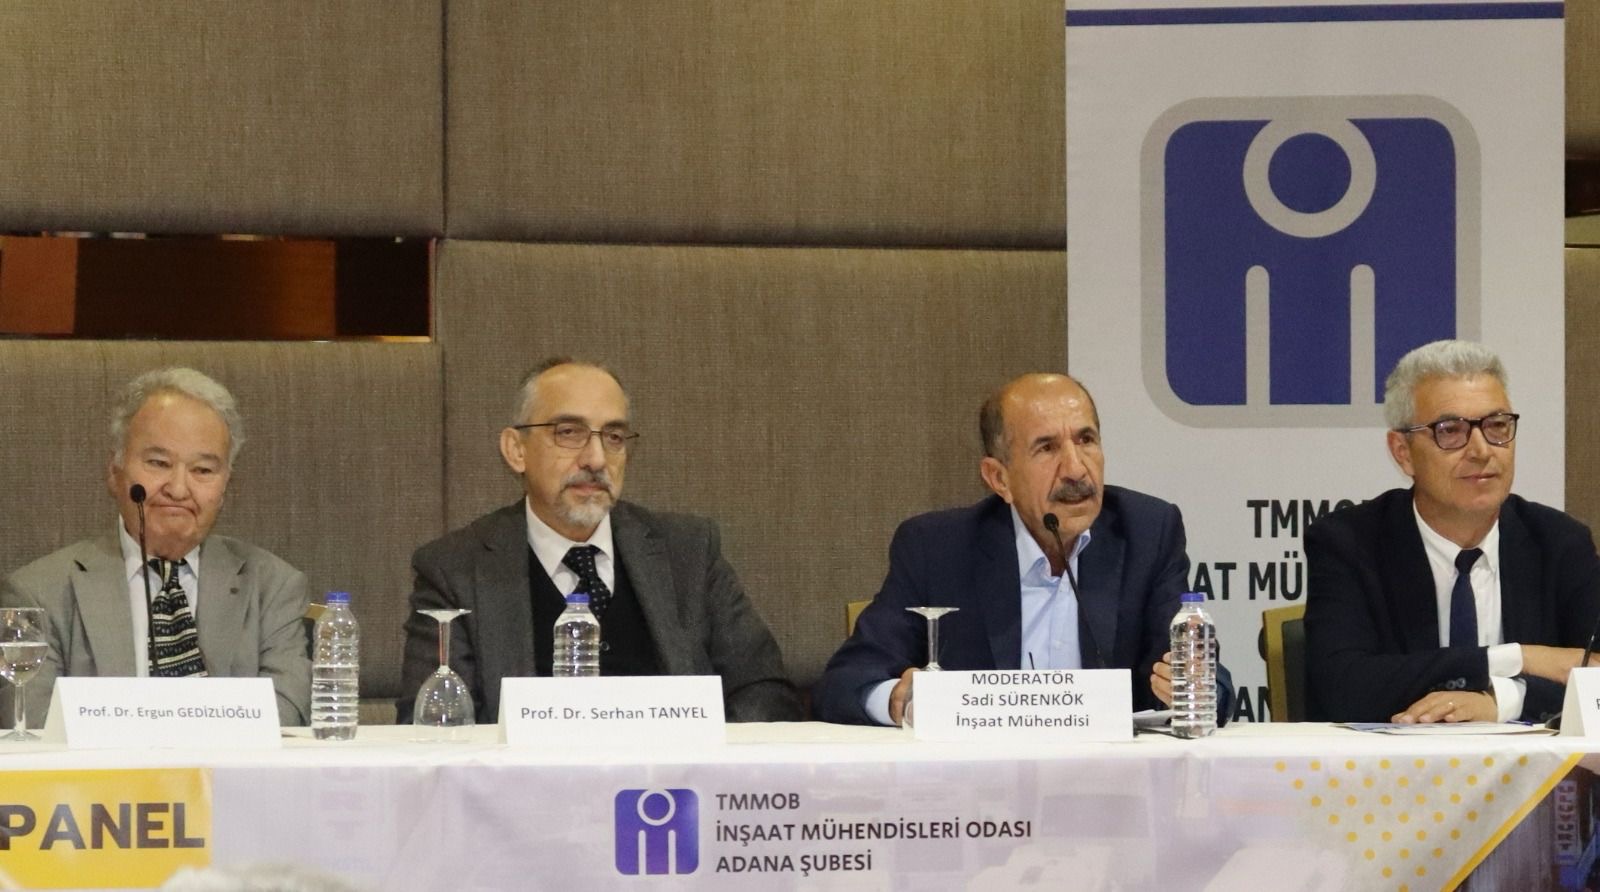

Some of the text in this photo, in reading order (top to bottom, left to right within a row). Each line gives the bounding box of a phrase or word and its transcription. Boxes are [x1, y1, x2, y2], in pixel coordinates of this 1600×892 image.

[971, 670, 1075, 685] MODERATÖR
[961, 691, 1084, 706] Sadi SÜRENKÖK
[79, 706, 262, 720] Prof. Dr. Ergun GEDİZLİOĞLU
[520, 707, 708, 720] Prof. Dr. Serhan TANYEL
[956, 712, 1090, 730] İnşaat Mühendisi
[716, 793, 800, 811] TMMOB
[0, 802, 205, 851] PANEL
[716, 816, 1032, 847] İNŞAAT MÜHENDİSLERİ ODASI
[716, 849, 872, 878] ADANA ŞUBESİ
